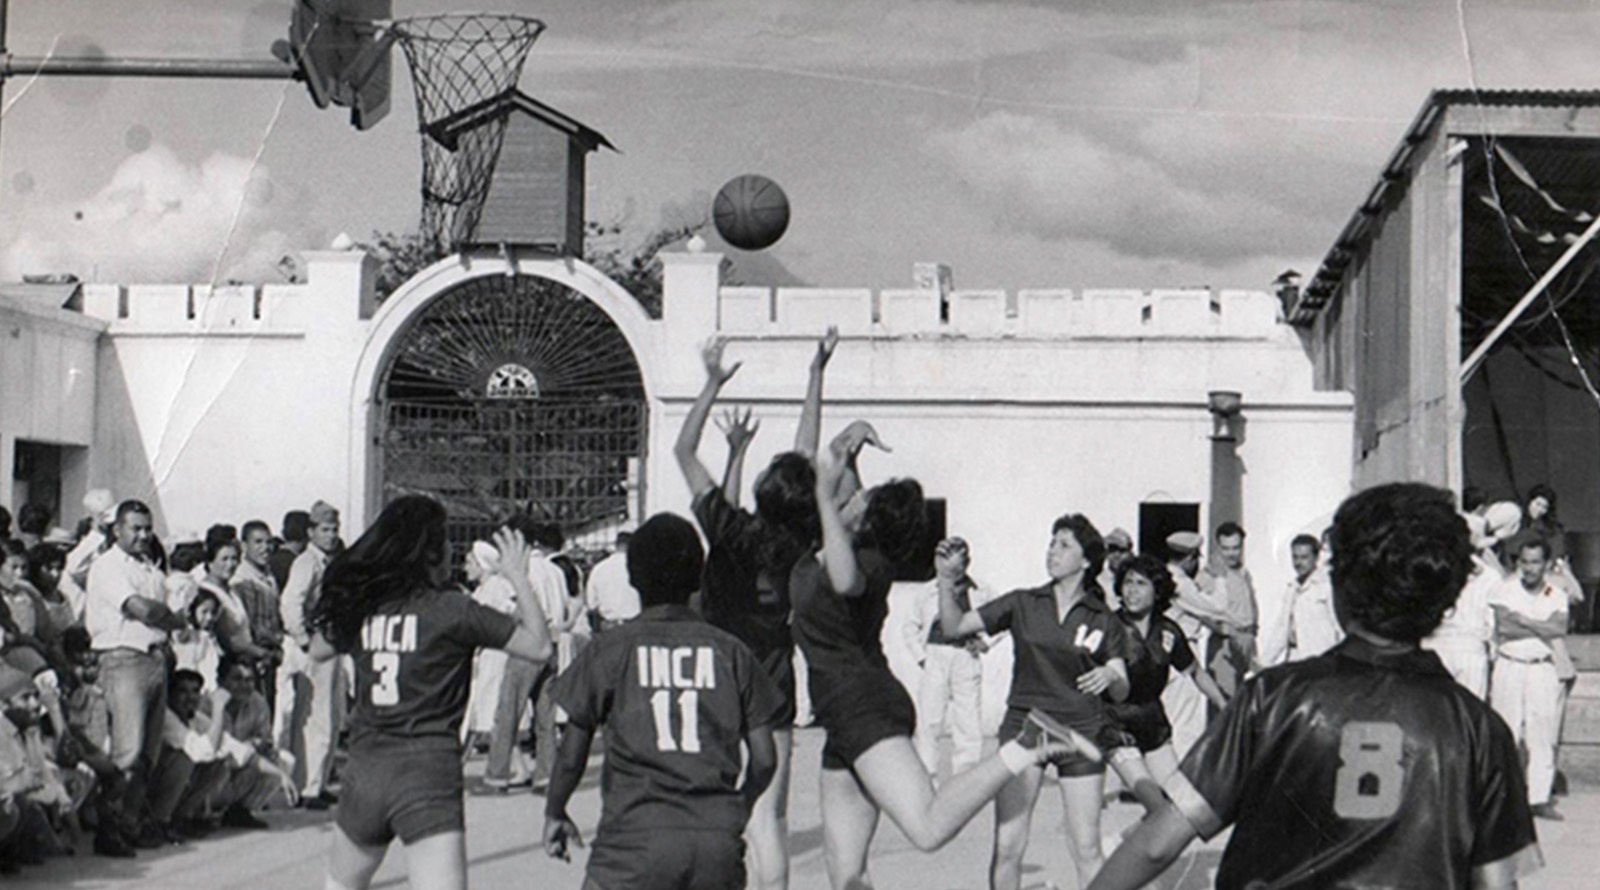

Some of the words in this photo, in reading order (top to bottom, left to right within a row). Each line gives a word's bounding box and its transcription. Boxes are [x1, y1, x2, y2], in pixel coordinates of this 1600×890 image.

[361, 614, 417, 652] INCA
[371, 652, 400, 706] 3
[637, 645, 716, 689] INCA
[650, 689, 701, 753] 11
[1333, 720, 1406, 820] 8
